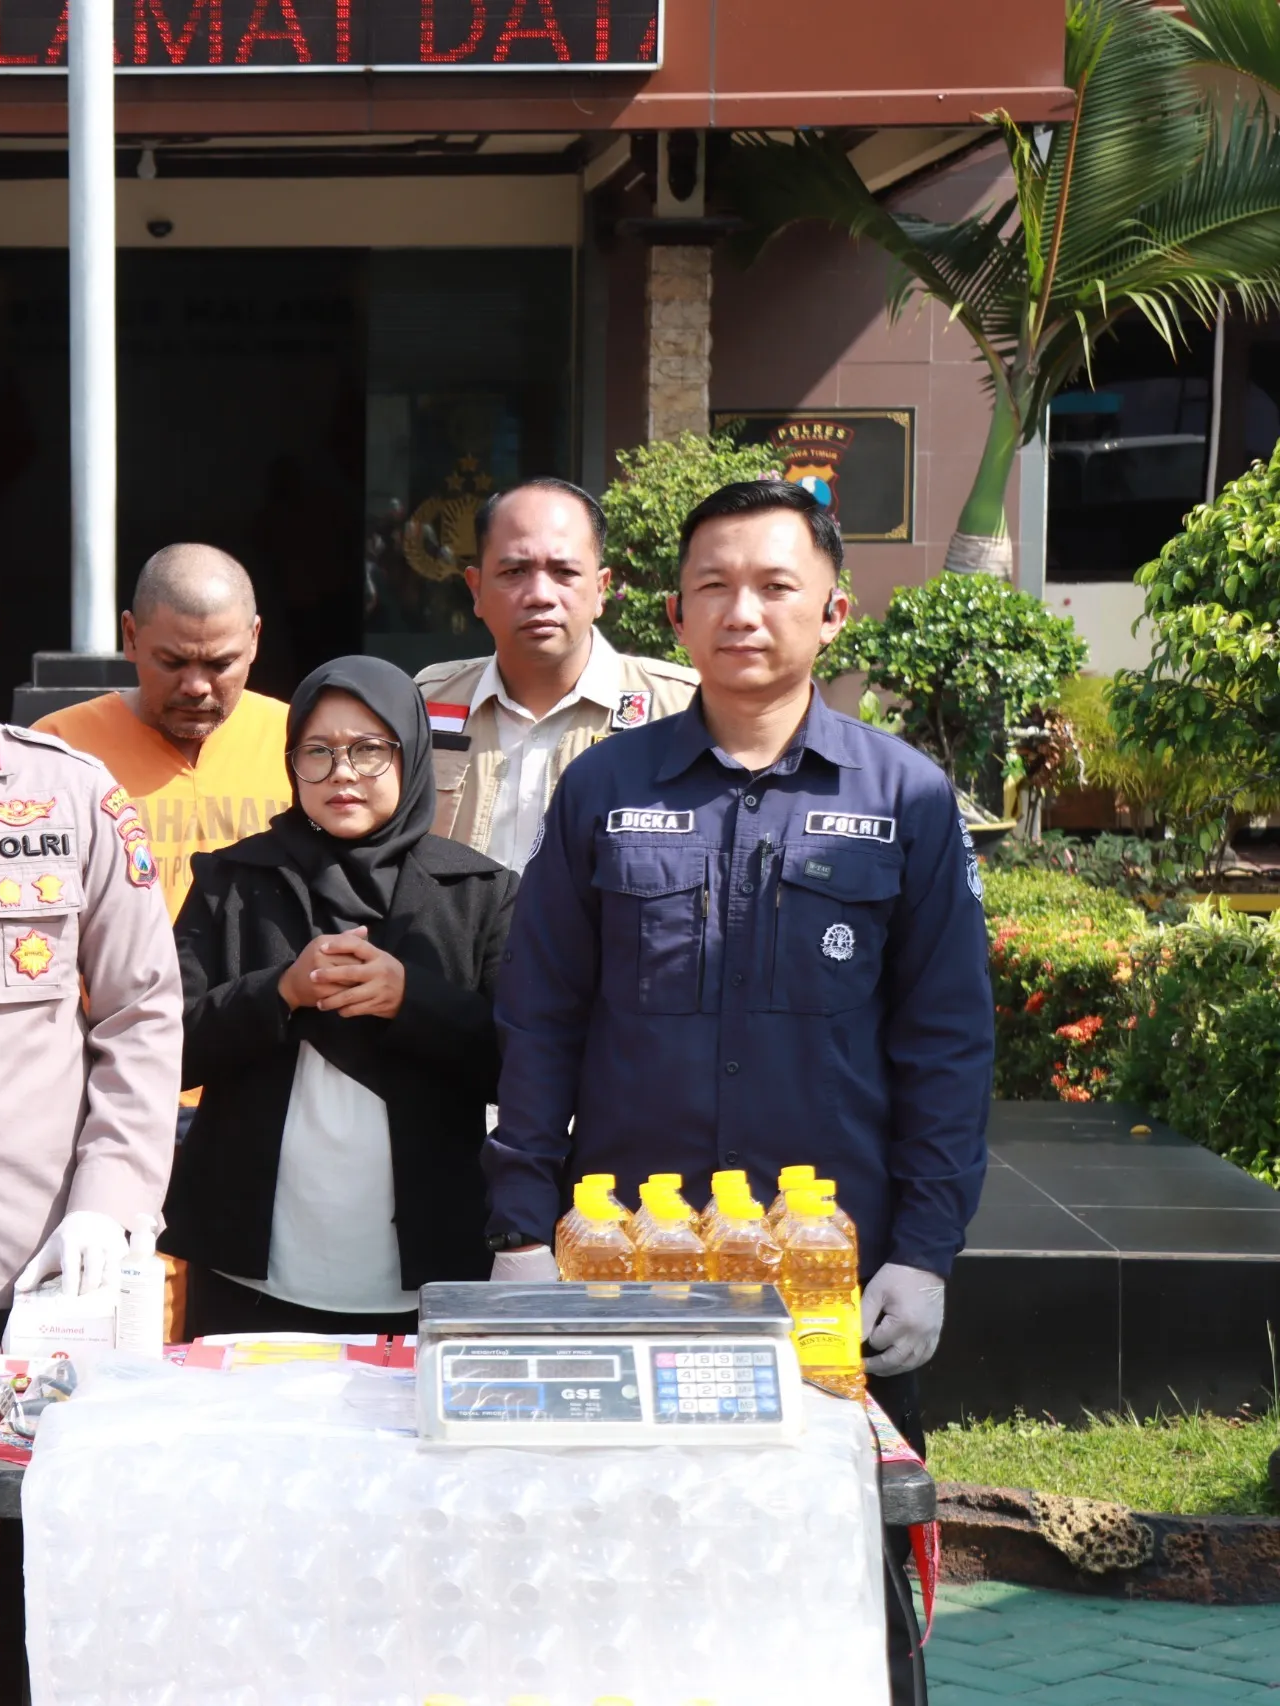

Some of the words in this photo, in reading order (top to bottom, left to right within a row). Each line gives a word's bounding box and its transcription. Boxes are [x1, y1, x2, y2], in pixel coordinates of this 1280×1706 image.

[777, 423, 847, 441] POLRES
[620, 812, 679, 829] DICKA
[821, 815, 881, 837] POLRI
[680, 1355, 691, 1364] 7
[700, 1355, 710, 1364] 8
[720, 1355, 730, 1364] 9
[681, 1370, 692, 1379] 4
[701, 1370, 711, 1379] 5
[720, 1370, 731, 1379] 6
[561, 1388, 601, 1400] GSE
[701, 1385, 712, 1395] 2
[721, 1385, 732, 1395] 3
